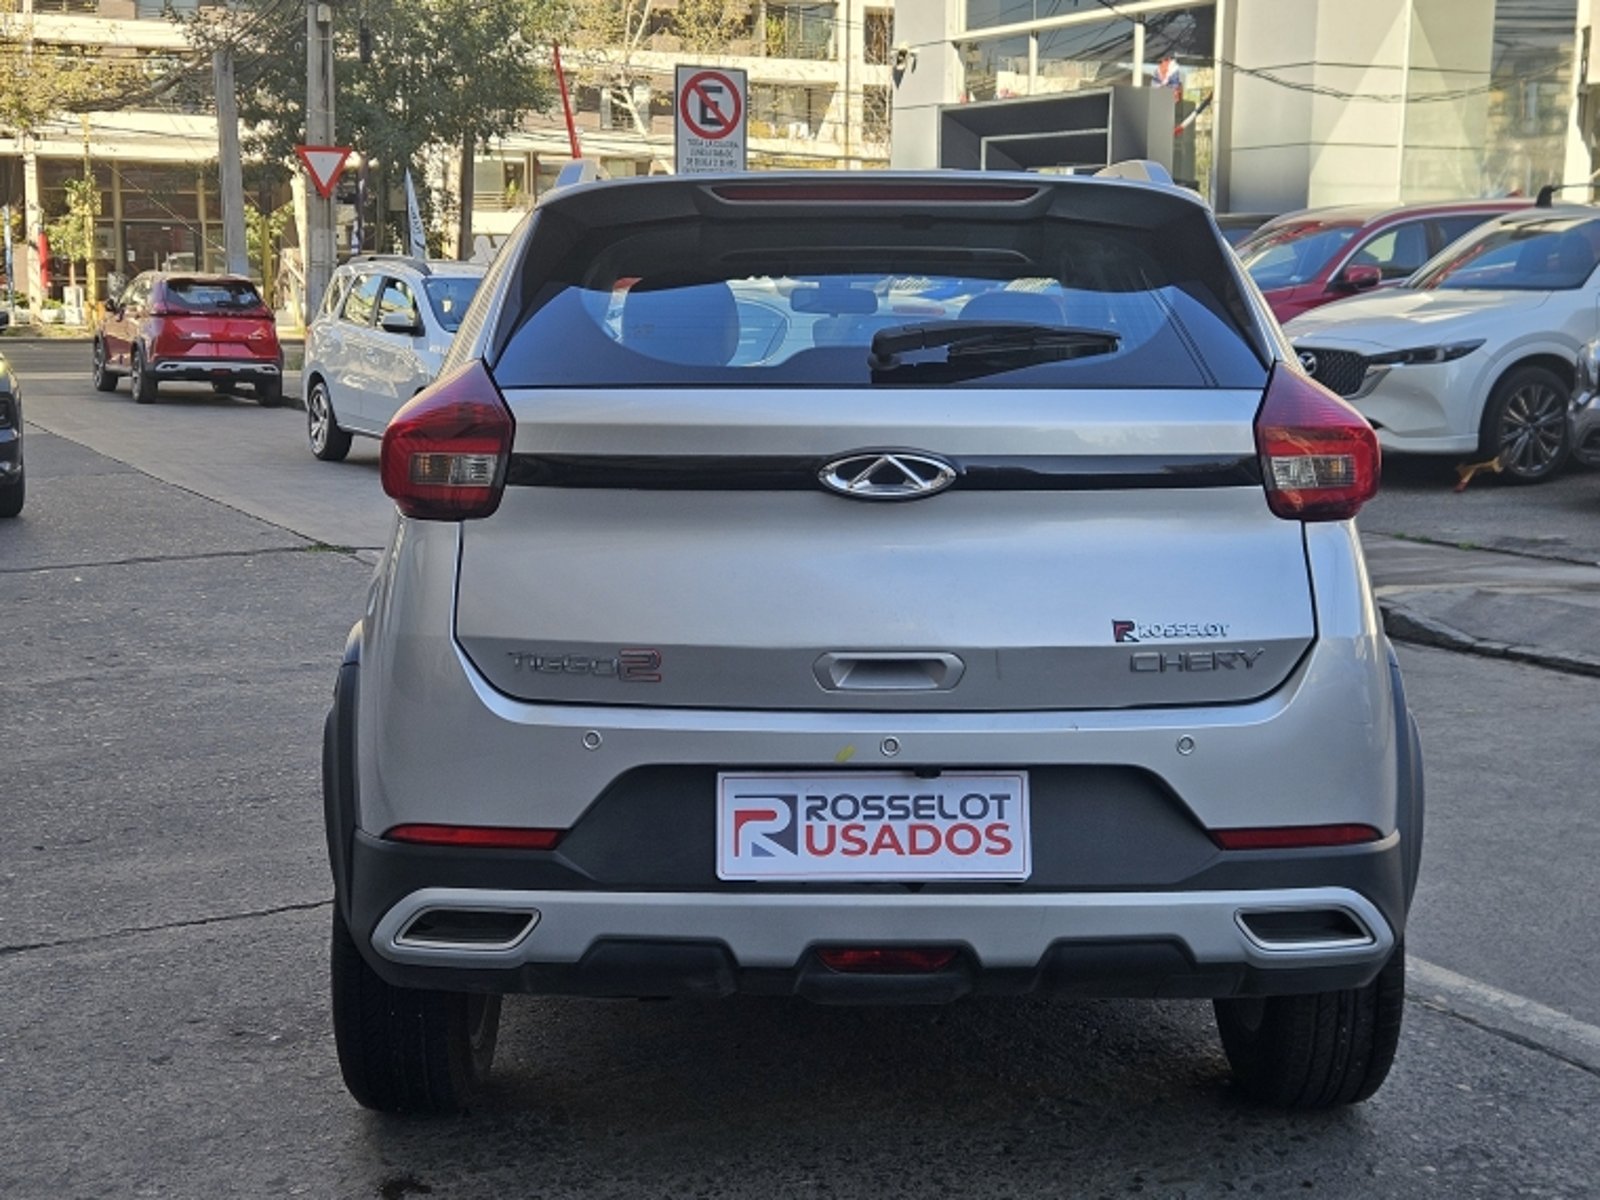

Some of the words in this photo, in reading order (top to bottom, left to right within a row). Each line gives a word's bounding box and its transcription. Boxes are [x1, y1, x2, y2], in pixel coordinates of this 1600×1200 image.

[699, 85, 724, 126] E
[1129, 647, 1265, 673] CHERY
[805, 793, 1011, 821] ROSSELOT
[805, 822, 1013, 857] USADOS
